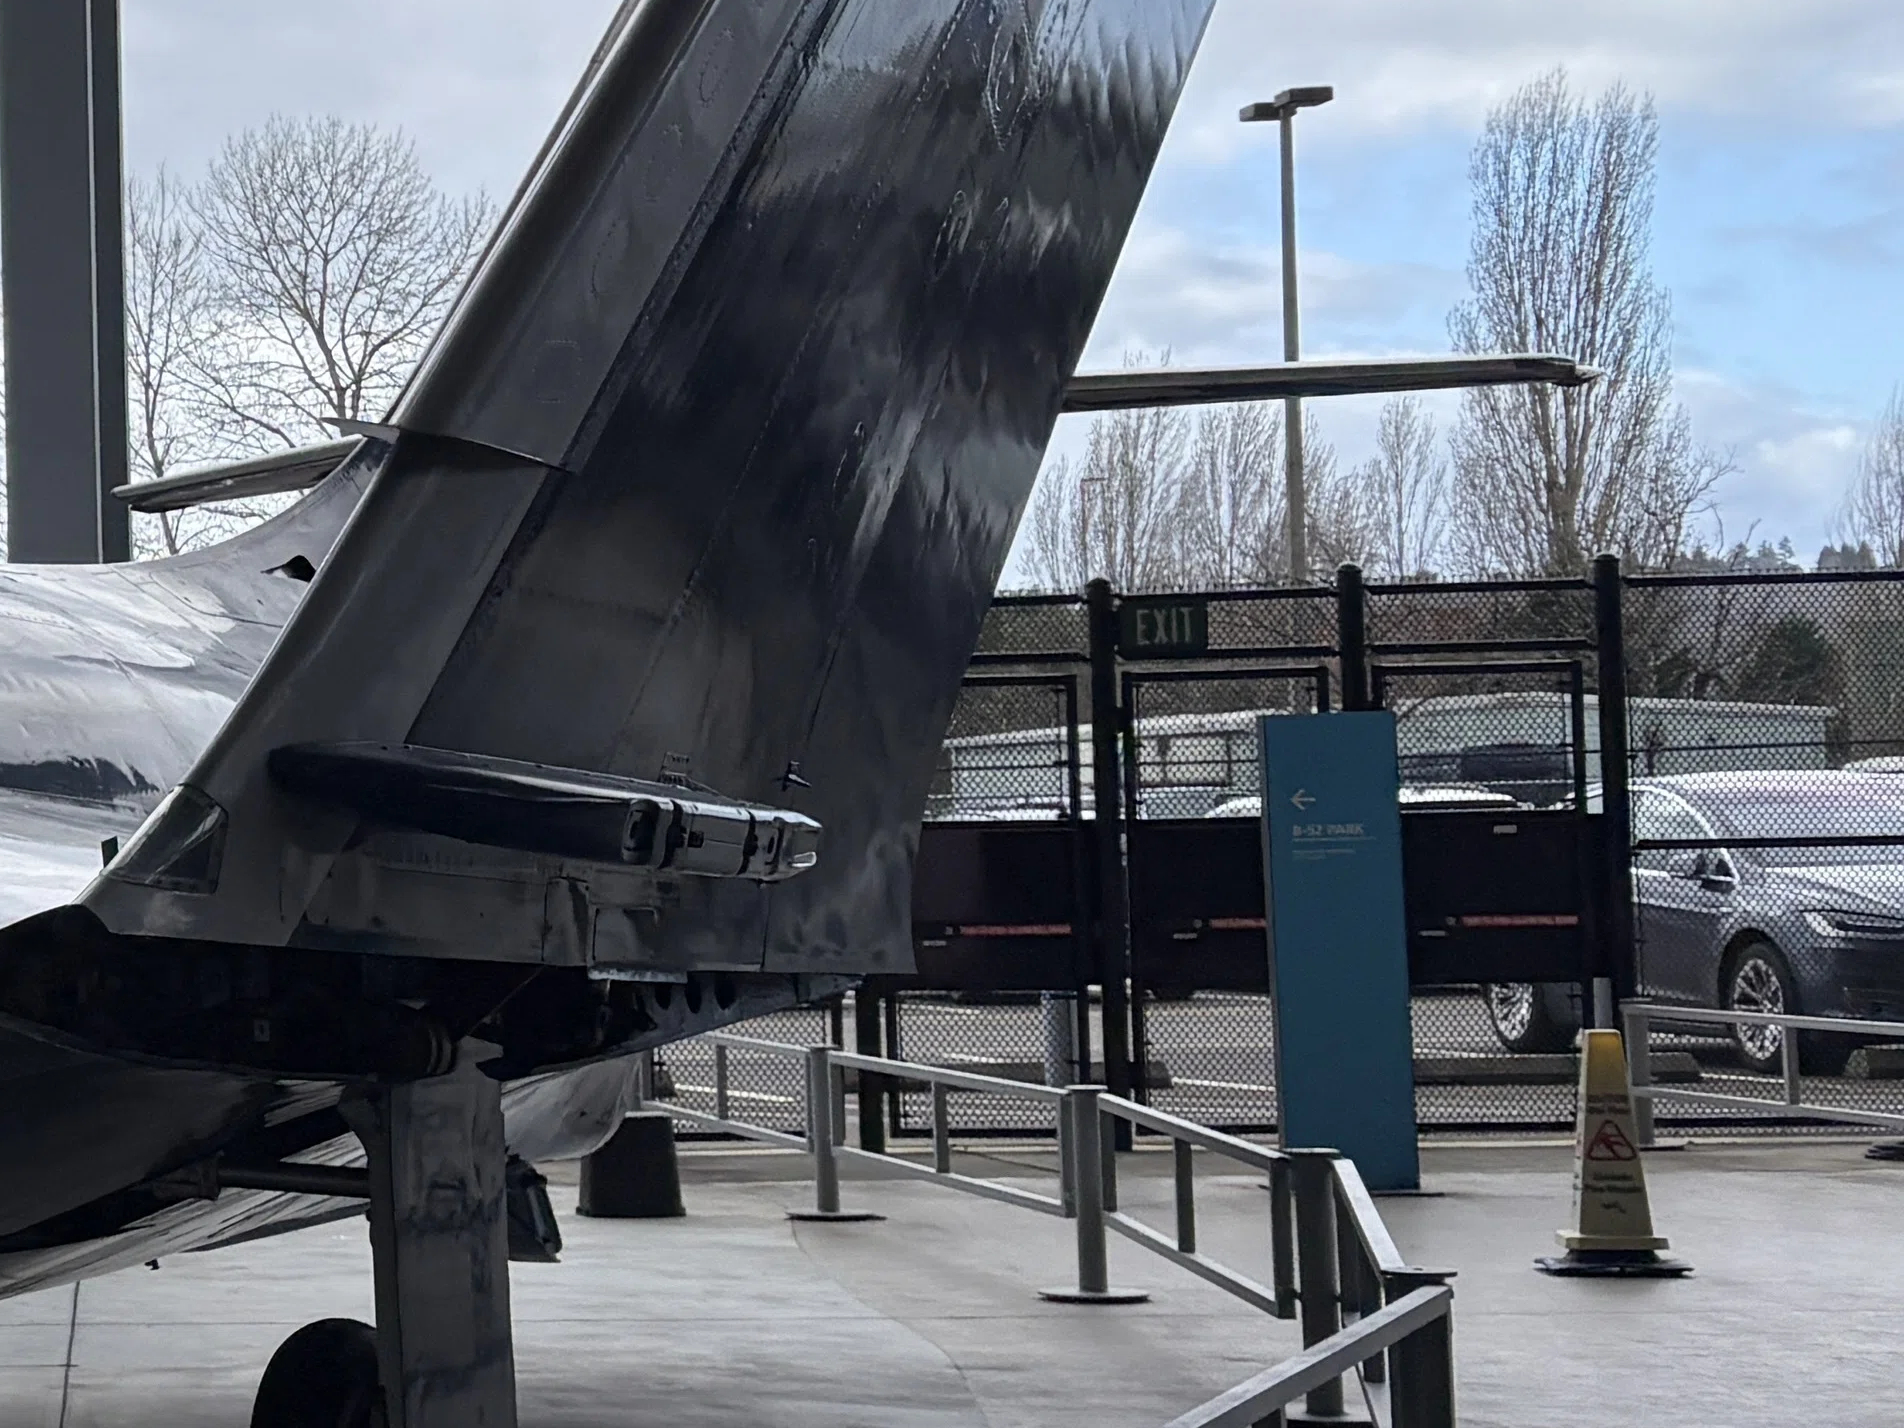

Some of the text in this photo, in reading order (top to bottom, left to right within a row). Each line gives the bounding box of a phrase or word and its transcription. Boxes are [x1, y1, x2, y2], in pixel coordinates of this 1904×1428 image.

[1136, 607, 1193, 645] EXIT
[1293, 823, 1364, 836] B-52 PARK
